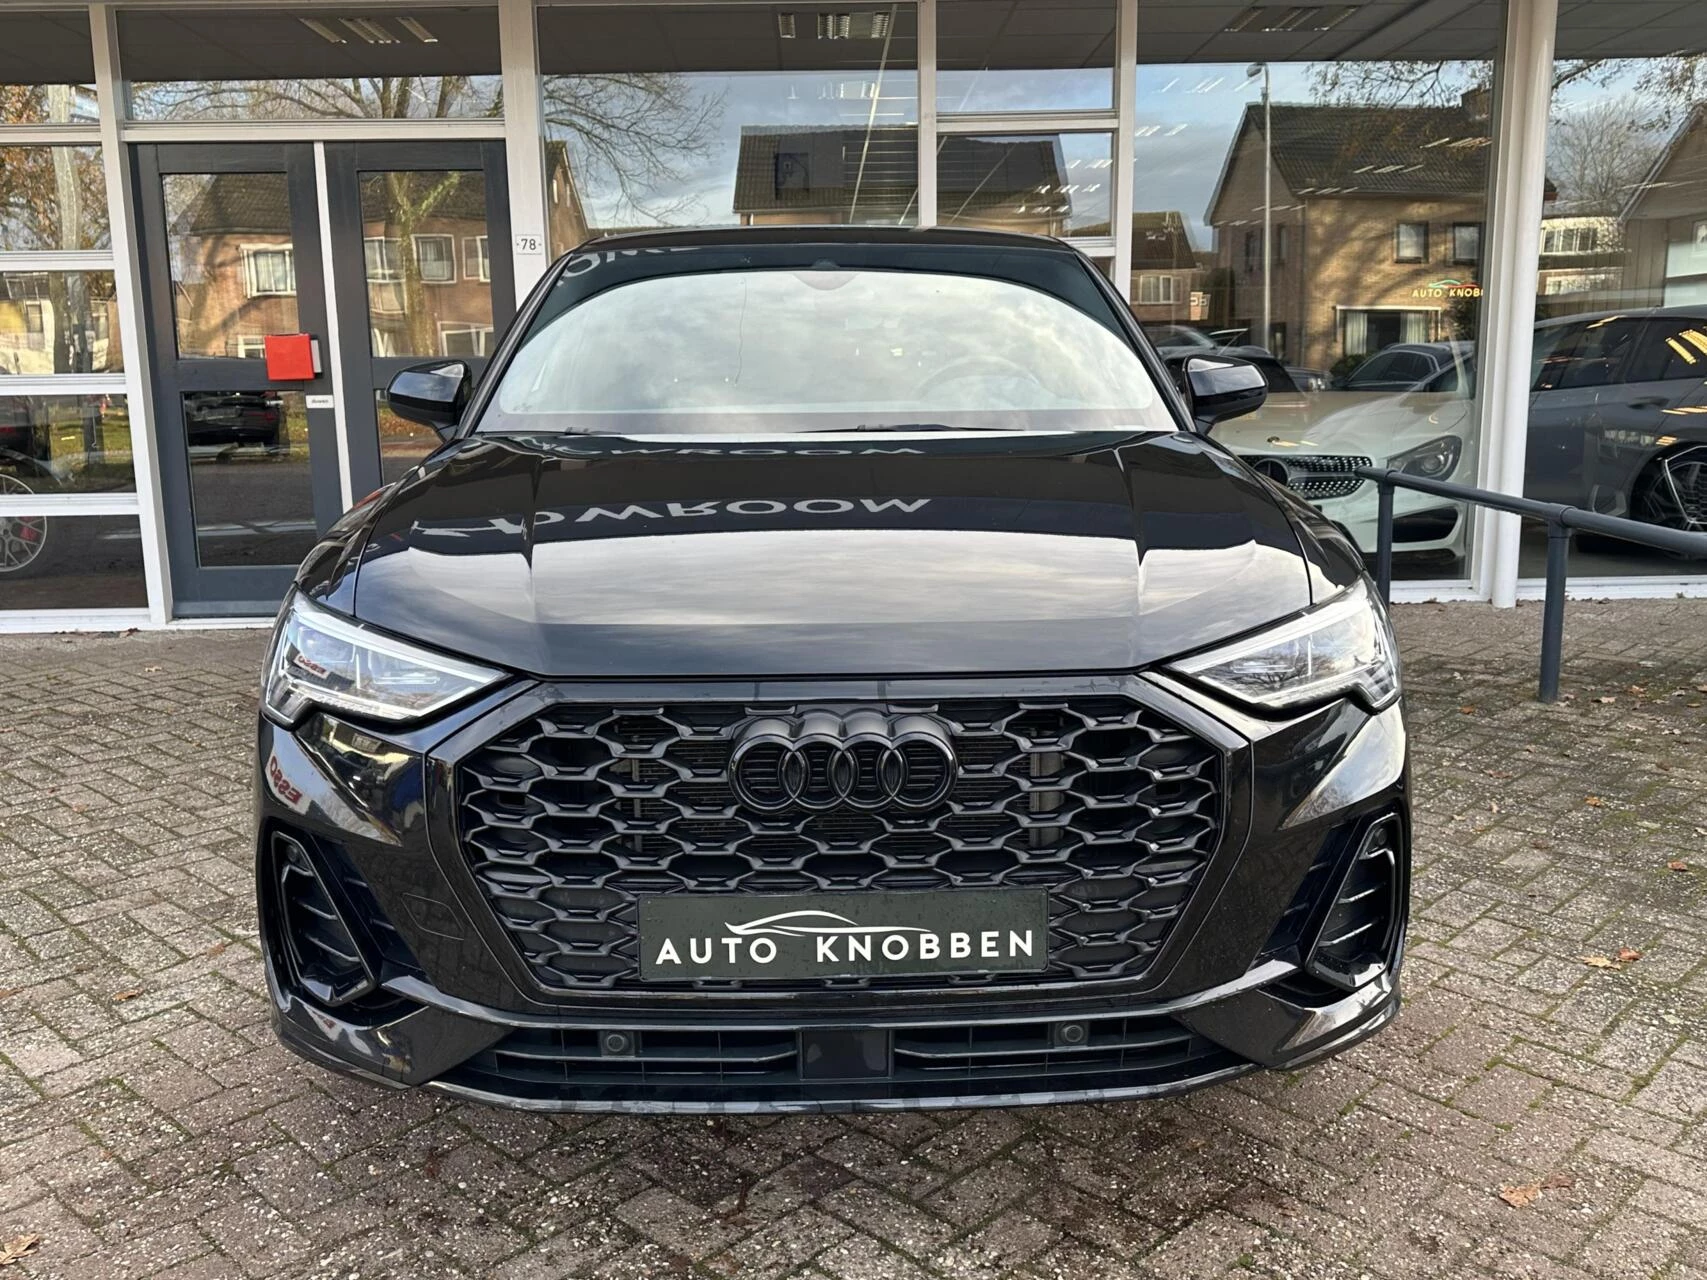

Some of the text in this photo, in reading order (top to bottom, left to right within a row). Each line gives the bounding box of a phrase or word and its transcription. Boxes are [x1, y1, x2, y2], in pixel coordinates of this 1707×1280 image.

[1412, 287, 1484, 298] AUTO KNOB
[655, 930, 1033, 965] AUTO KNOBBEN
